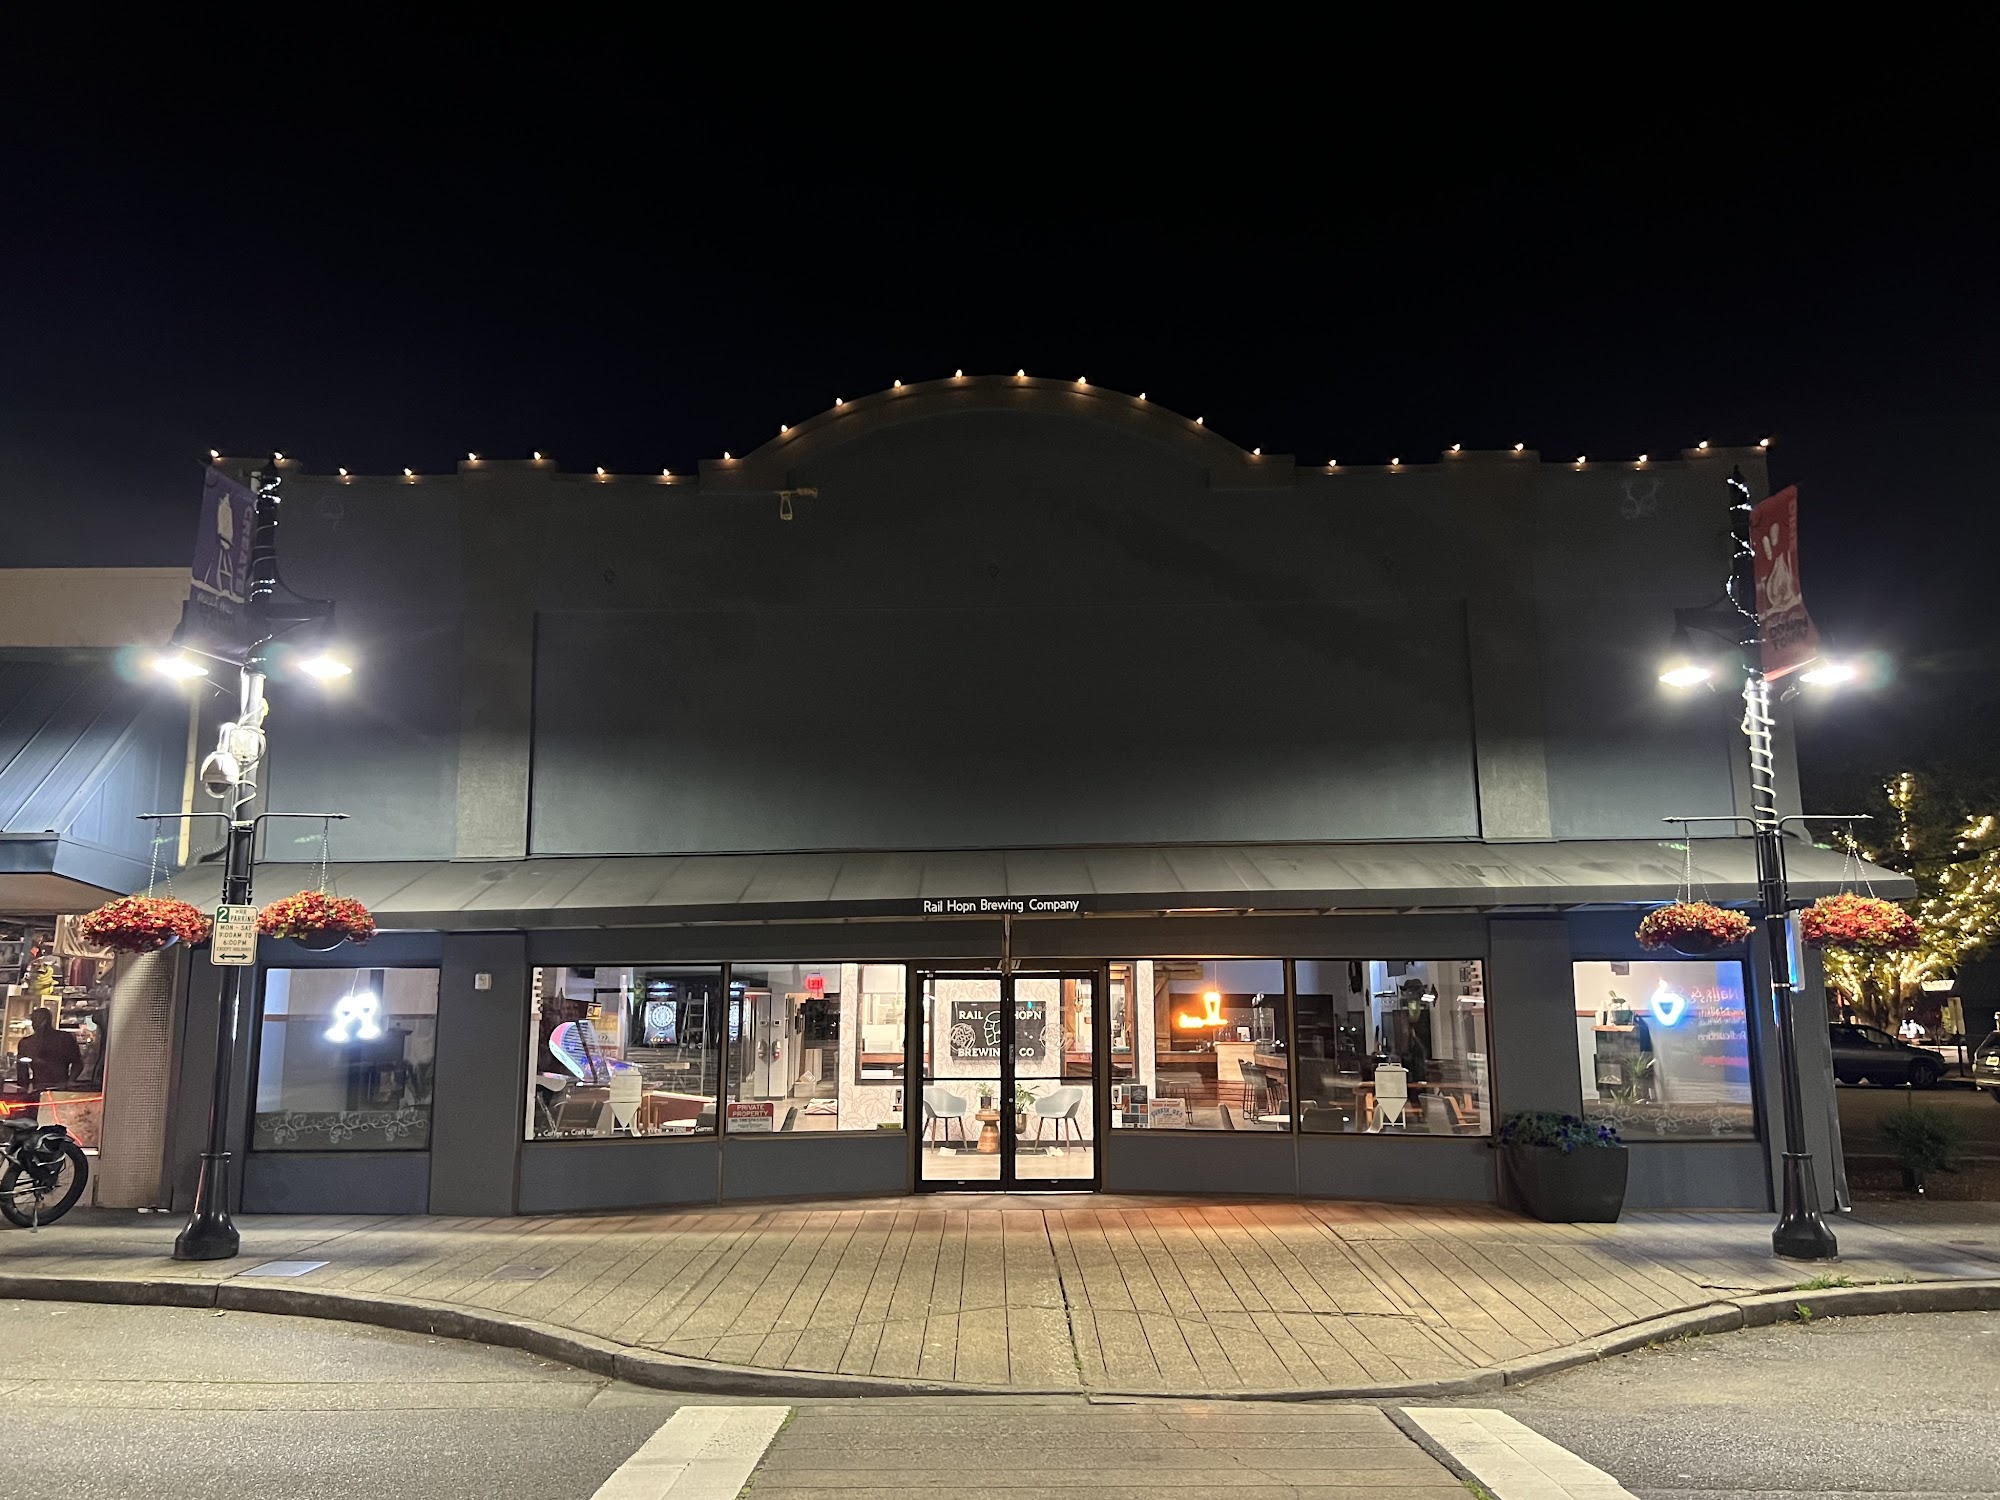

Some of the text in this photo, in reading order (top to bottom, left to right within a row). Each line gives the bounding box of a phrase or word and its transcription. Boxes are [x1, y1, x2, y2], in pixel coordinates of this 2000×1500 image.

[923, 900, 943, 913] Rail
[980, 898, 1024, 913] Brewing
[1028, 898, 1080, 912] Company
[218, 907, 228, 922] 2
[959, 1010, 984, 1020] RAIL
[957, 1047, 1035, 1057] BREWIN CO
[542, 1129, 563, 1138] Coffee
[571, 1128, 586, 1136] Craft
